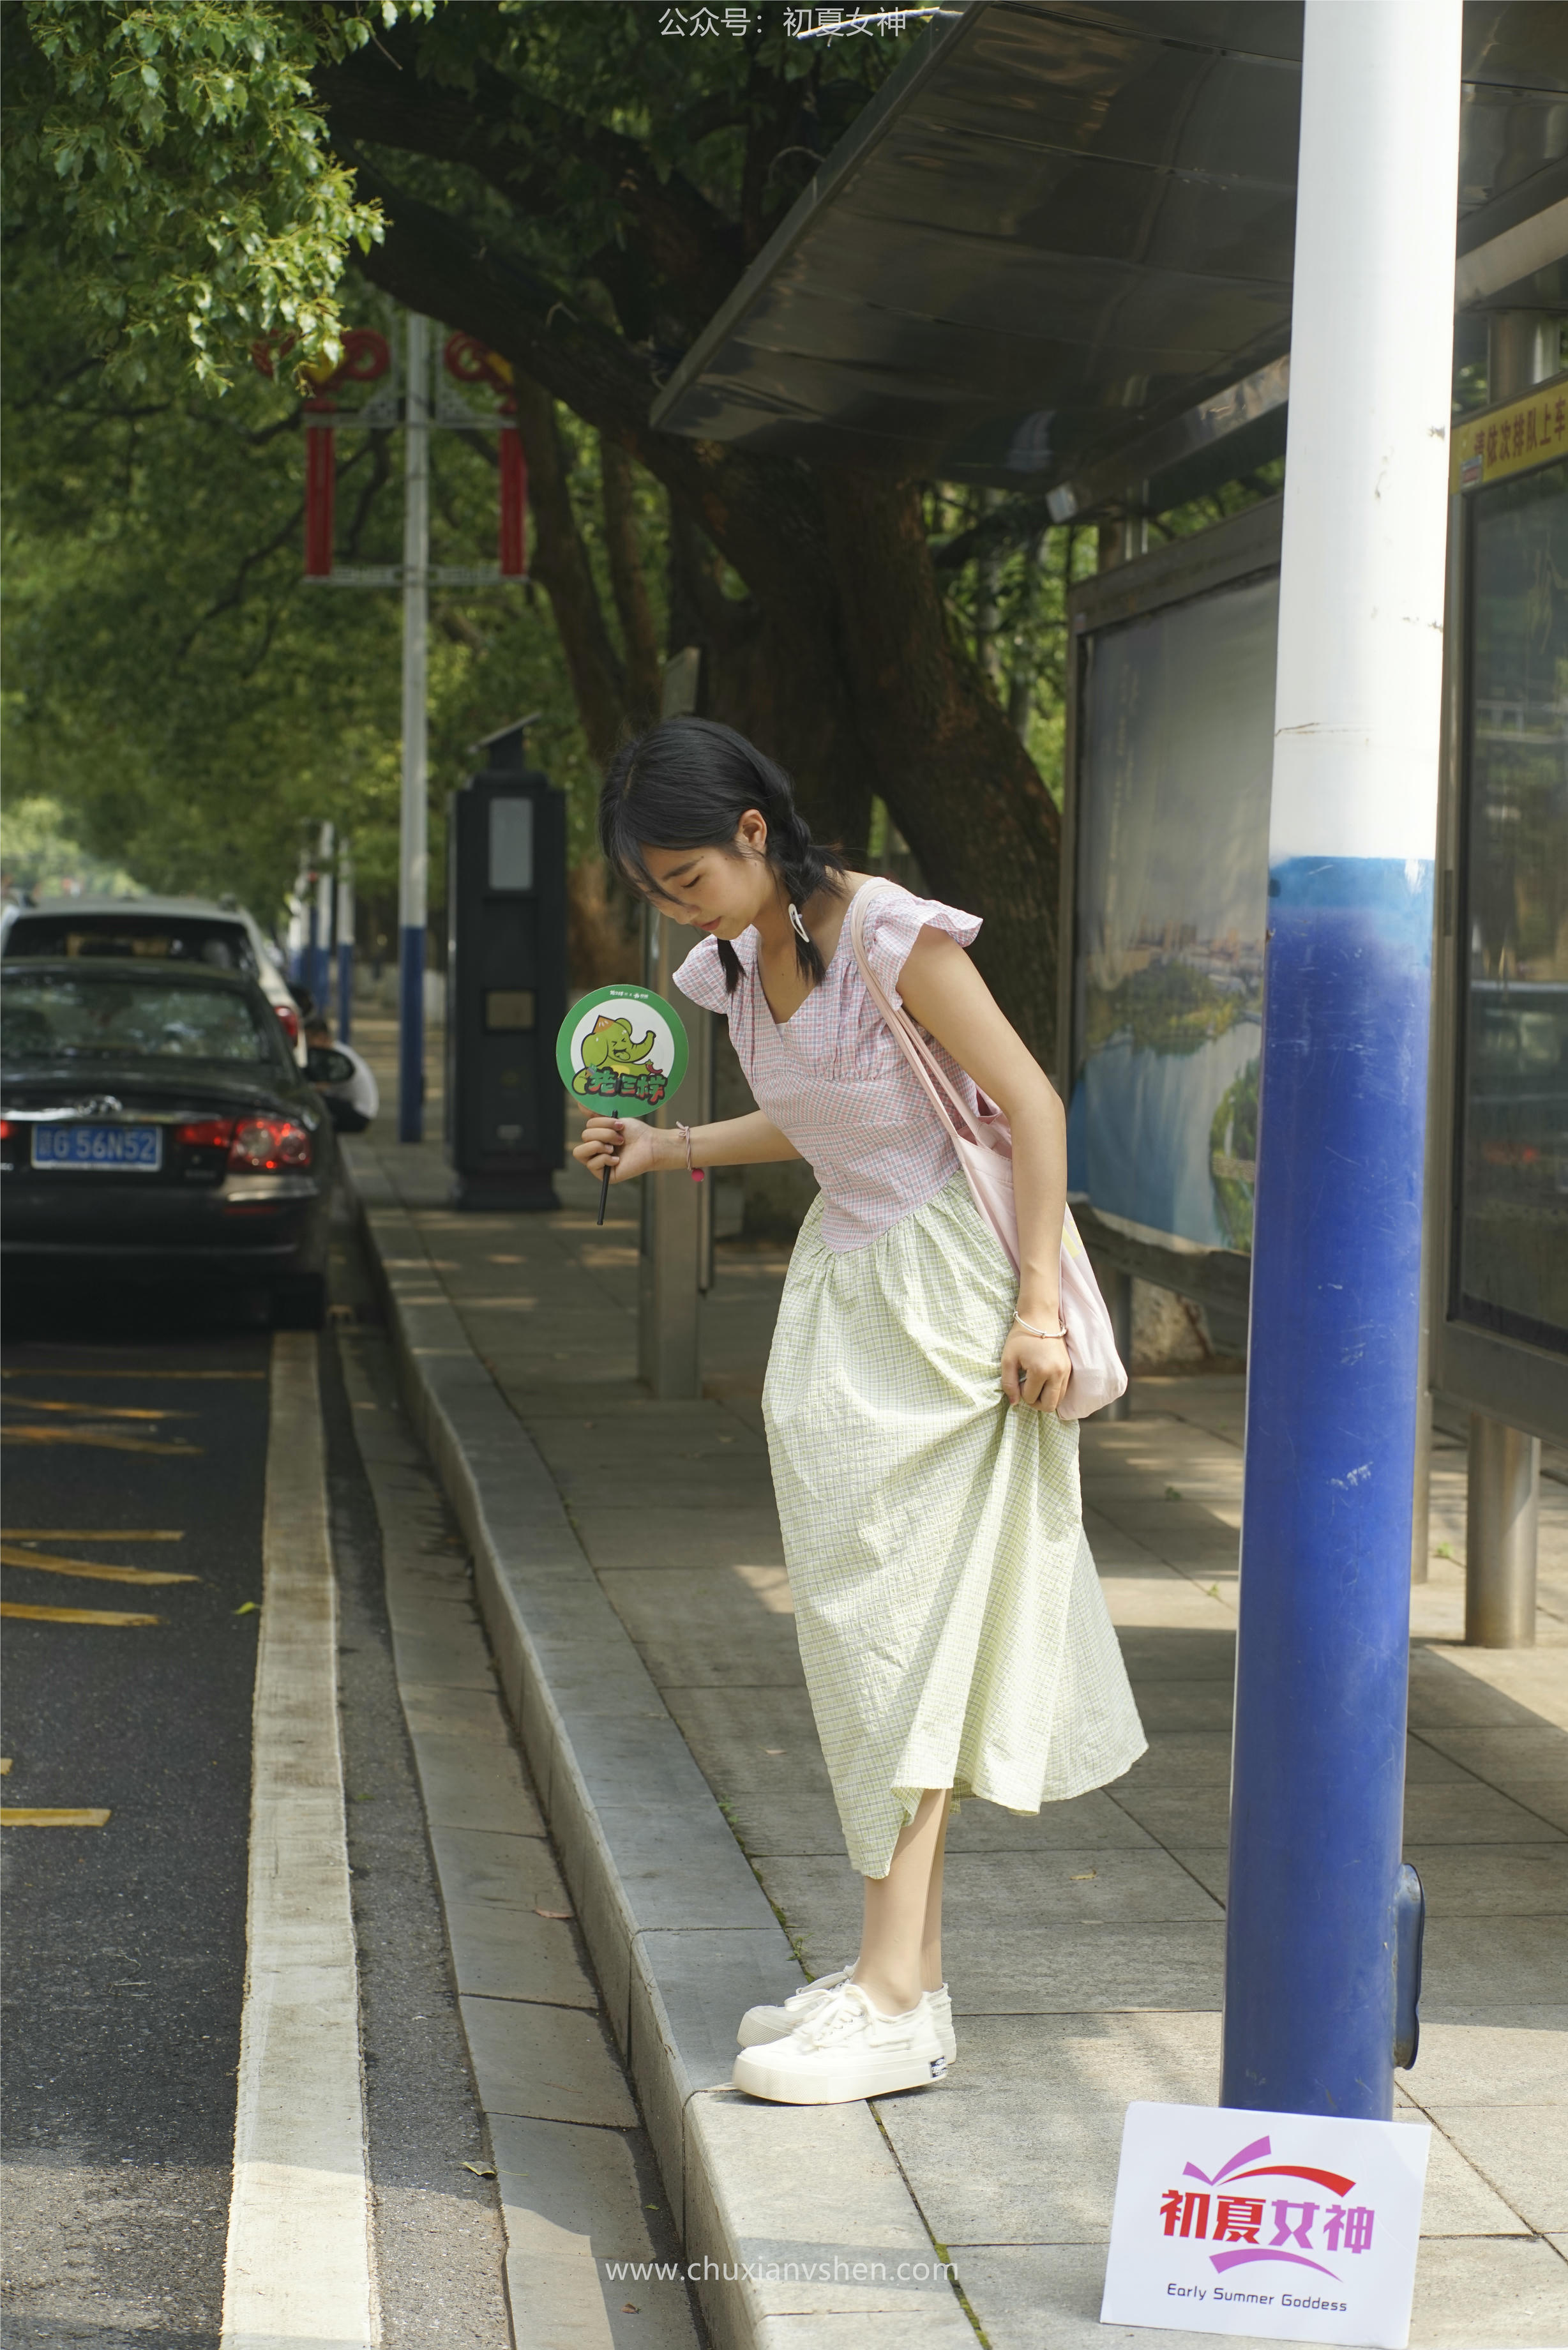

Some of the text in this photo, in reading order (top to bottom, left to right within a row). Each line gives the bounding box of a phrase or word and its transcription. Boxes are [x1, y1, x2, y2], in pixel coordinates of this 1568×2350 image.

[1159, 2189, 1375, 2254] 初夏女神
[1166, 2283, 1348, 2312] Early Summer Goddess
